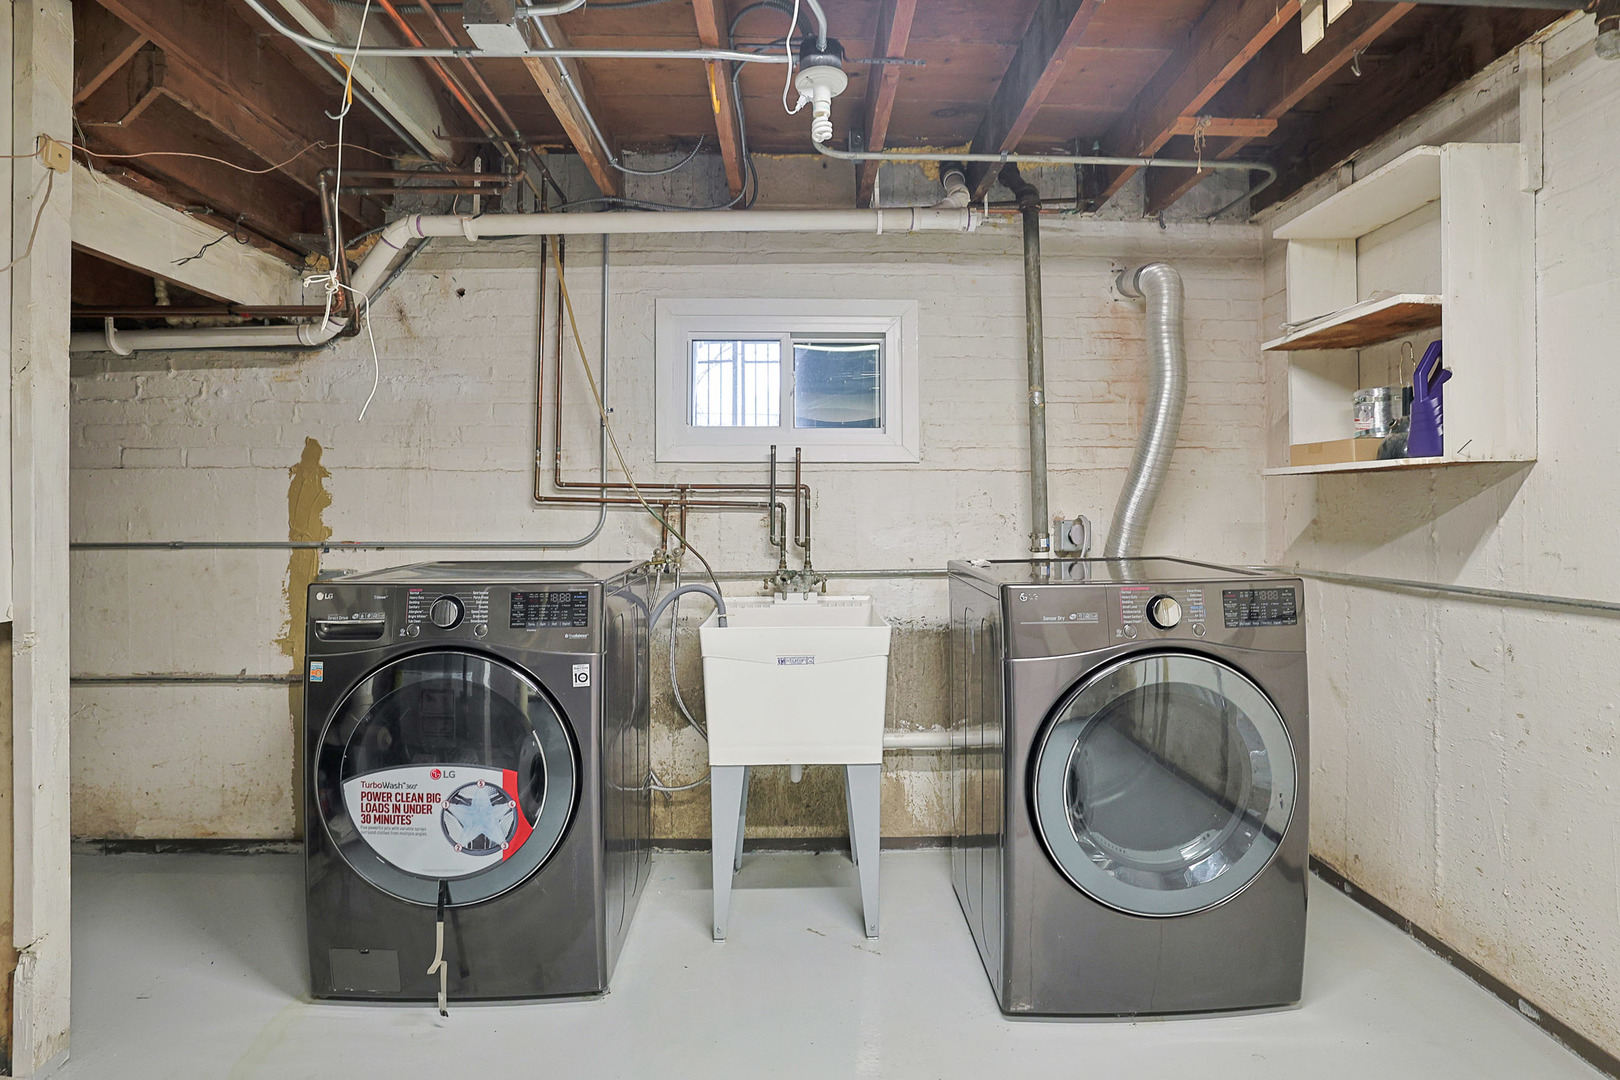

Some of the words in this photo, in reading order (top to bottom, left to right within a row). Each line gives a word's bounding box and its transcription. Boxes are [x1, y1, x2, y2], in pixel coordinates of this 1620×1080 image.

[443, 770, 456, 778] LG
[361, 791, 392, 802] POWER
[395, 792, 424, 803] CLEAN
[426, 793, 441, 804] BIG
[361, 803, 390, 813] LOADS
[392, 803, 401, 814] IN
[403, 804, 433, 814] UNDER
[361, 814, 371, 824] 30
